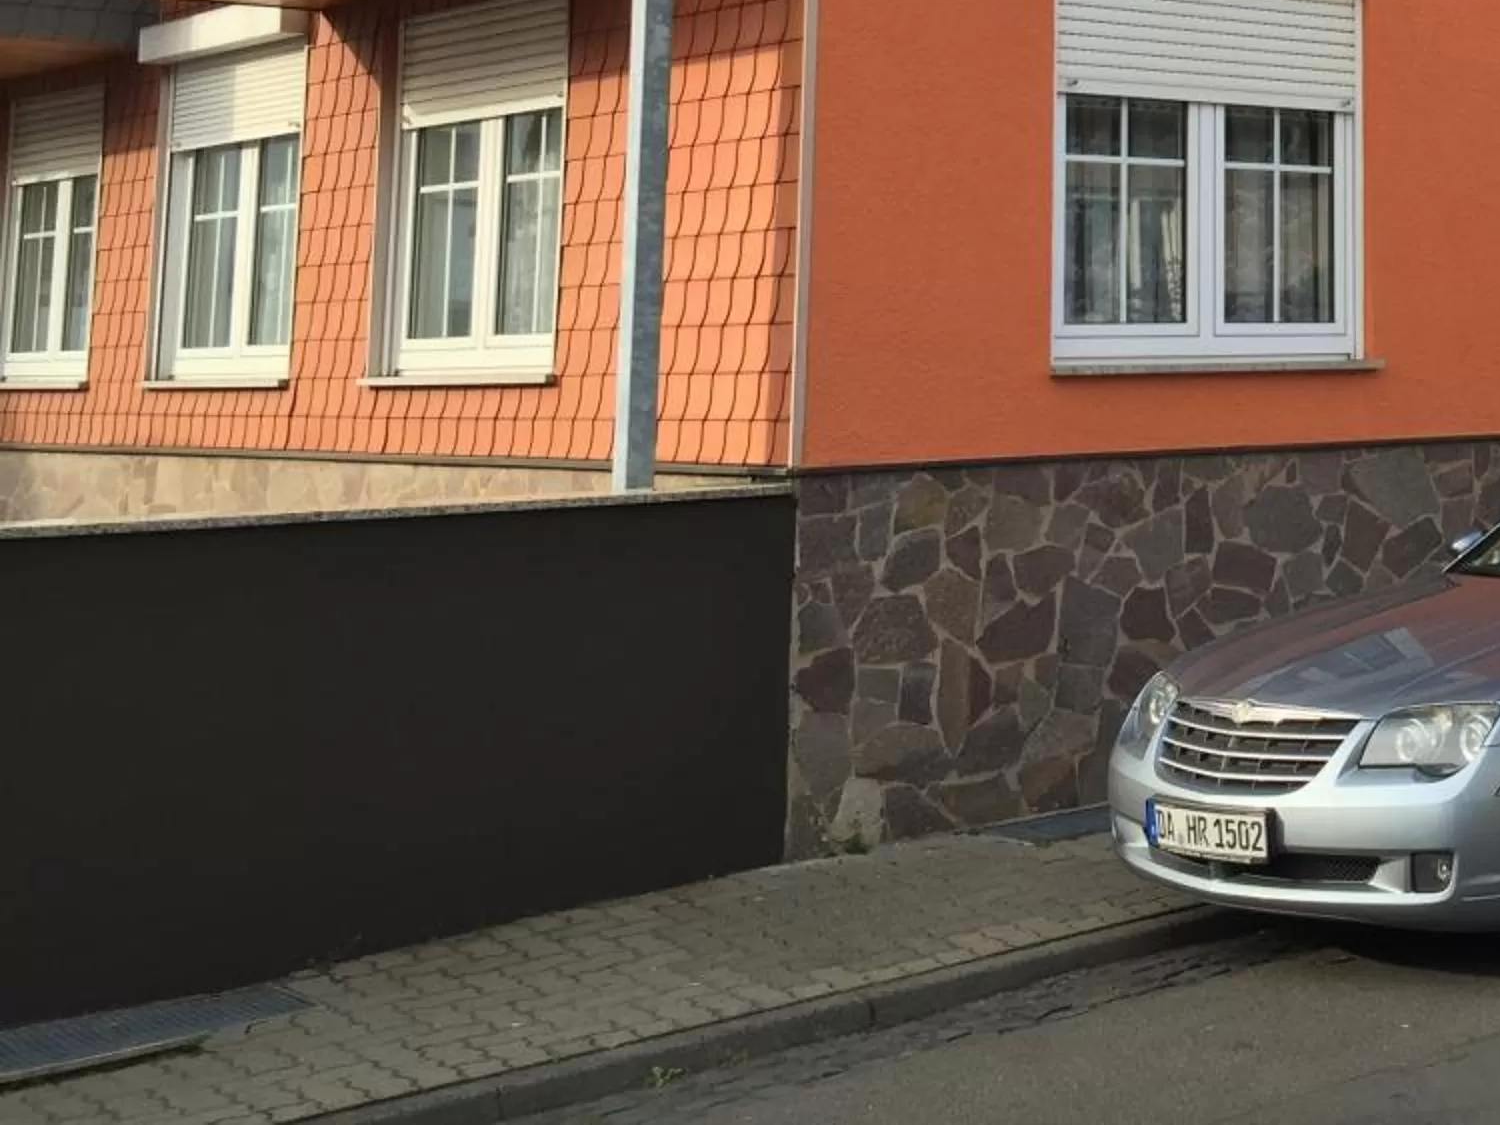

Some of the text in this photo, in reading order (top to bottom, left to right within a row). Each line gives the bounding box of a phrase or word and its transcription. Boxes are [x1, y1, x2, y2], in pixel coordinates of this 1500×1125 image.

[1157, 809, 1264, 852] DA HR 1502
